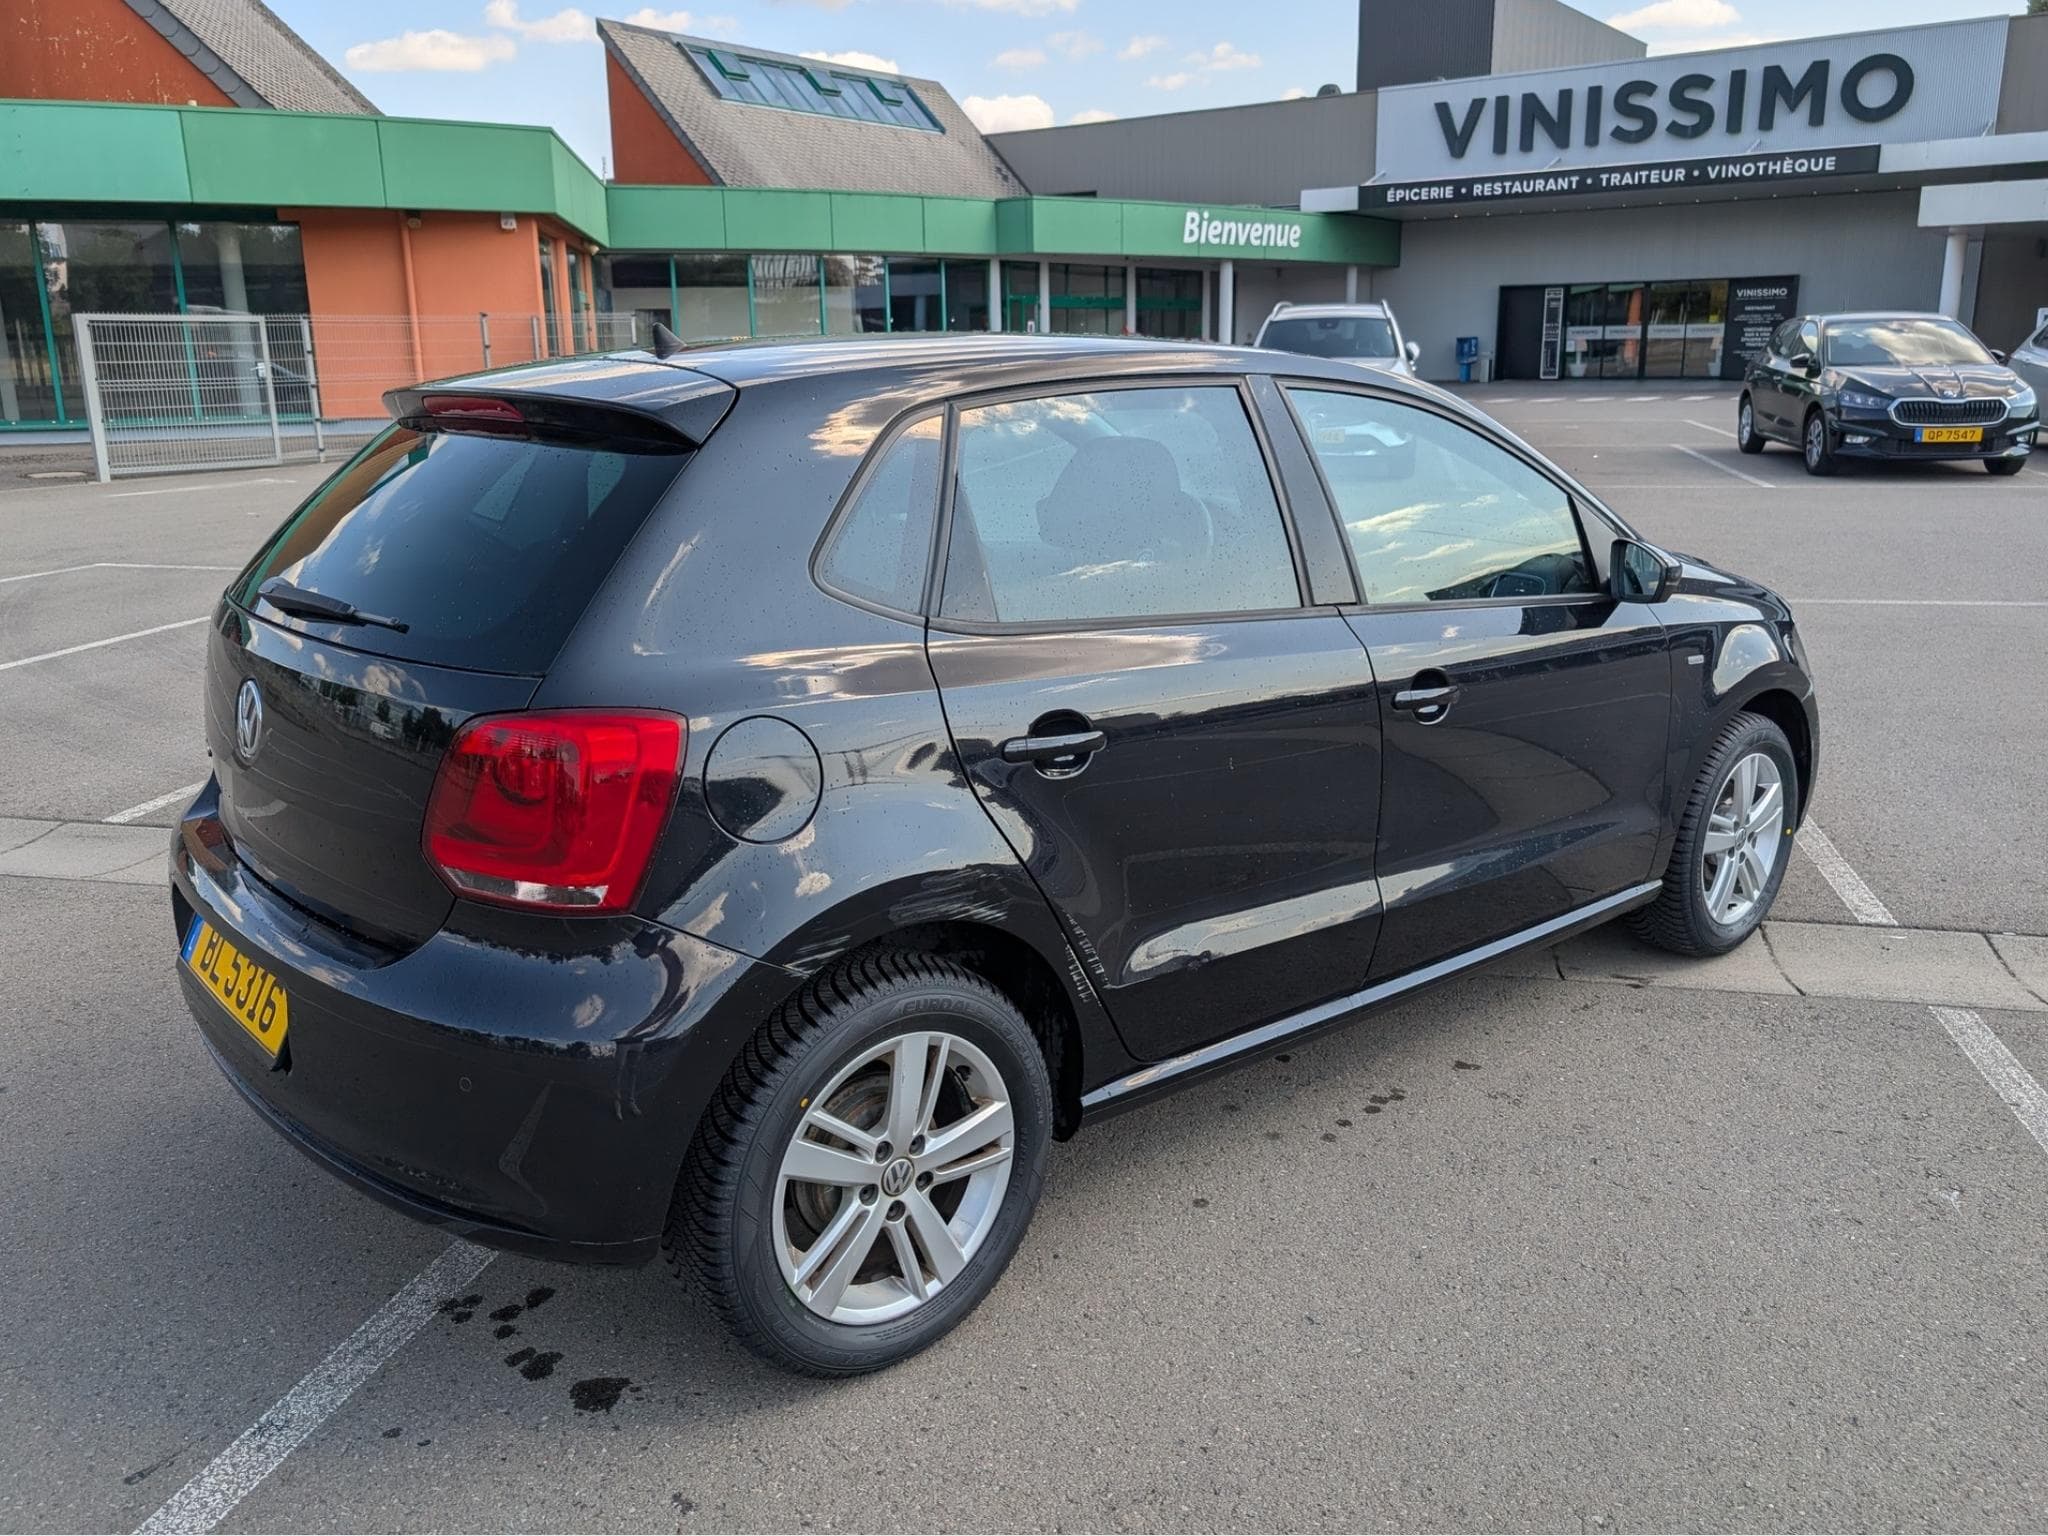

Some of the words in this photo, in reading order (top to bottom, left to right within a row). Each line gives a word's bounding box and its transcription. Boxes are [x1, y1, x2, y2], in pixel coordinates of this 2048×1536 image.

[1434, 52, 1915, 159] VINISSIMO
[1386, 186, 1454, 203] ÉPICERIE
[1473, 176, 1579, 197] RESTAURANT
[1600, 168, 1686, 187] TRAITEUR
[1707, 156, 1837, 179] VINOTHÈQUE
[1183, 210, 1301, 248] Bienvenue
[1736, 287, 1788, 298] VINISSIMO
[1946, 430, 1976, 441] 7547
[224, 950, 284, 1034] 5316
